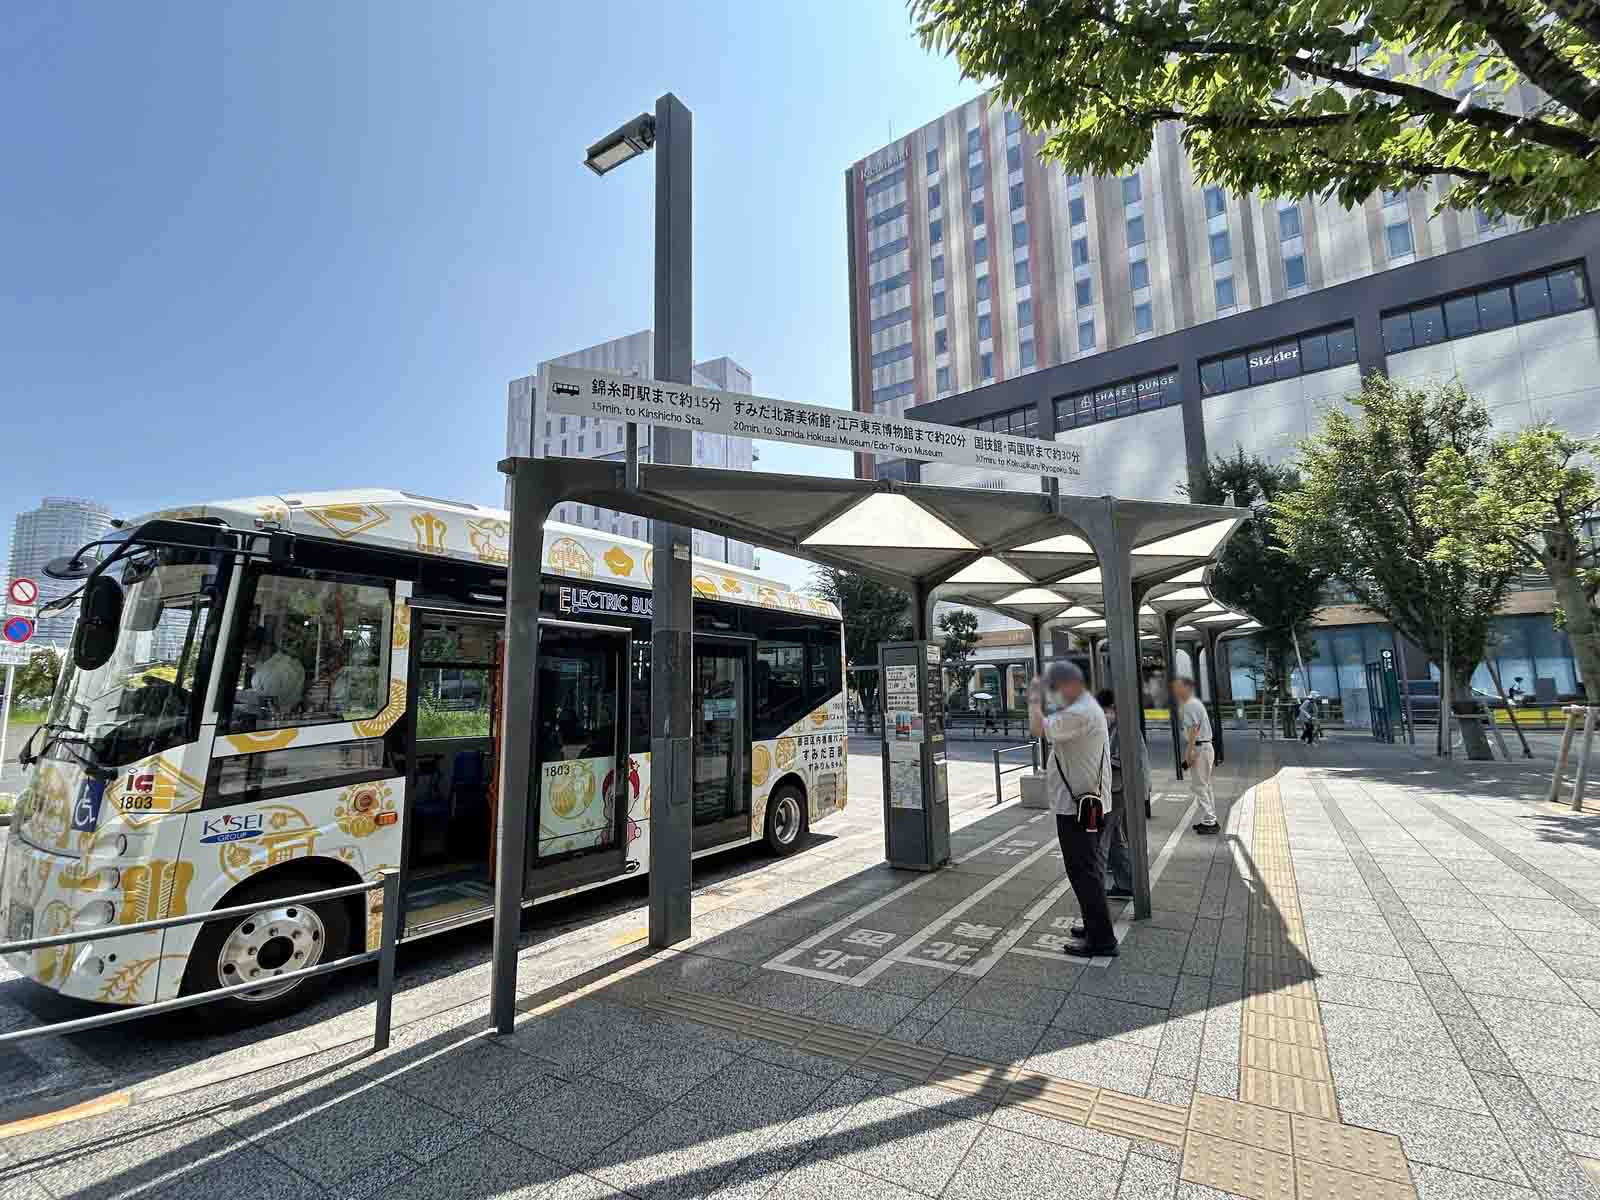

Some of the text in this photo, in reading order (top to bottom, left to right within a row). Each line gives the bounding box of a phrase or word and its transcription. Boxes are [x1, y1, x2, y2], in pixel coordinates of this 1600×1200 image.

[592, 378, 721, 413] 錦糸町駅まで約15分
[1095, 376, 1175, 401] SHARE LOUNGE
[592, 402, 704, 426] 15min. to Kinshicho Sta.
[733, 400, 967, 448] すみだ北斎美術館・江戸東京博物館まで約20分
[763, 425, 773, 435] to
[775, 427, 804, 440] Sumida
[806, 432, 838, 444] Hokusai
[914, 446, 943, 458] Museum
[974, 436, 1080, 463] 国技館・両国駅まで約30分
[560, 586, 628, 613] ELECTRIC
[544, 764, 570, 777] 1803
[120, 796, 153, 810] 1803
[216, 831, 247, 842] GROUP
